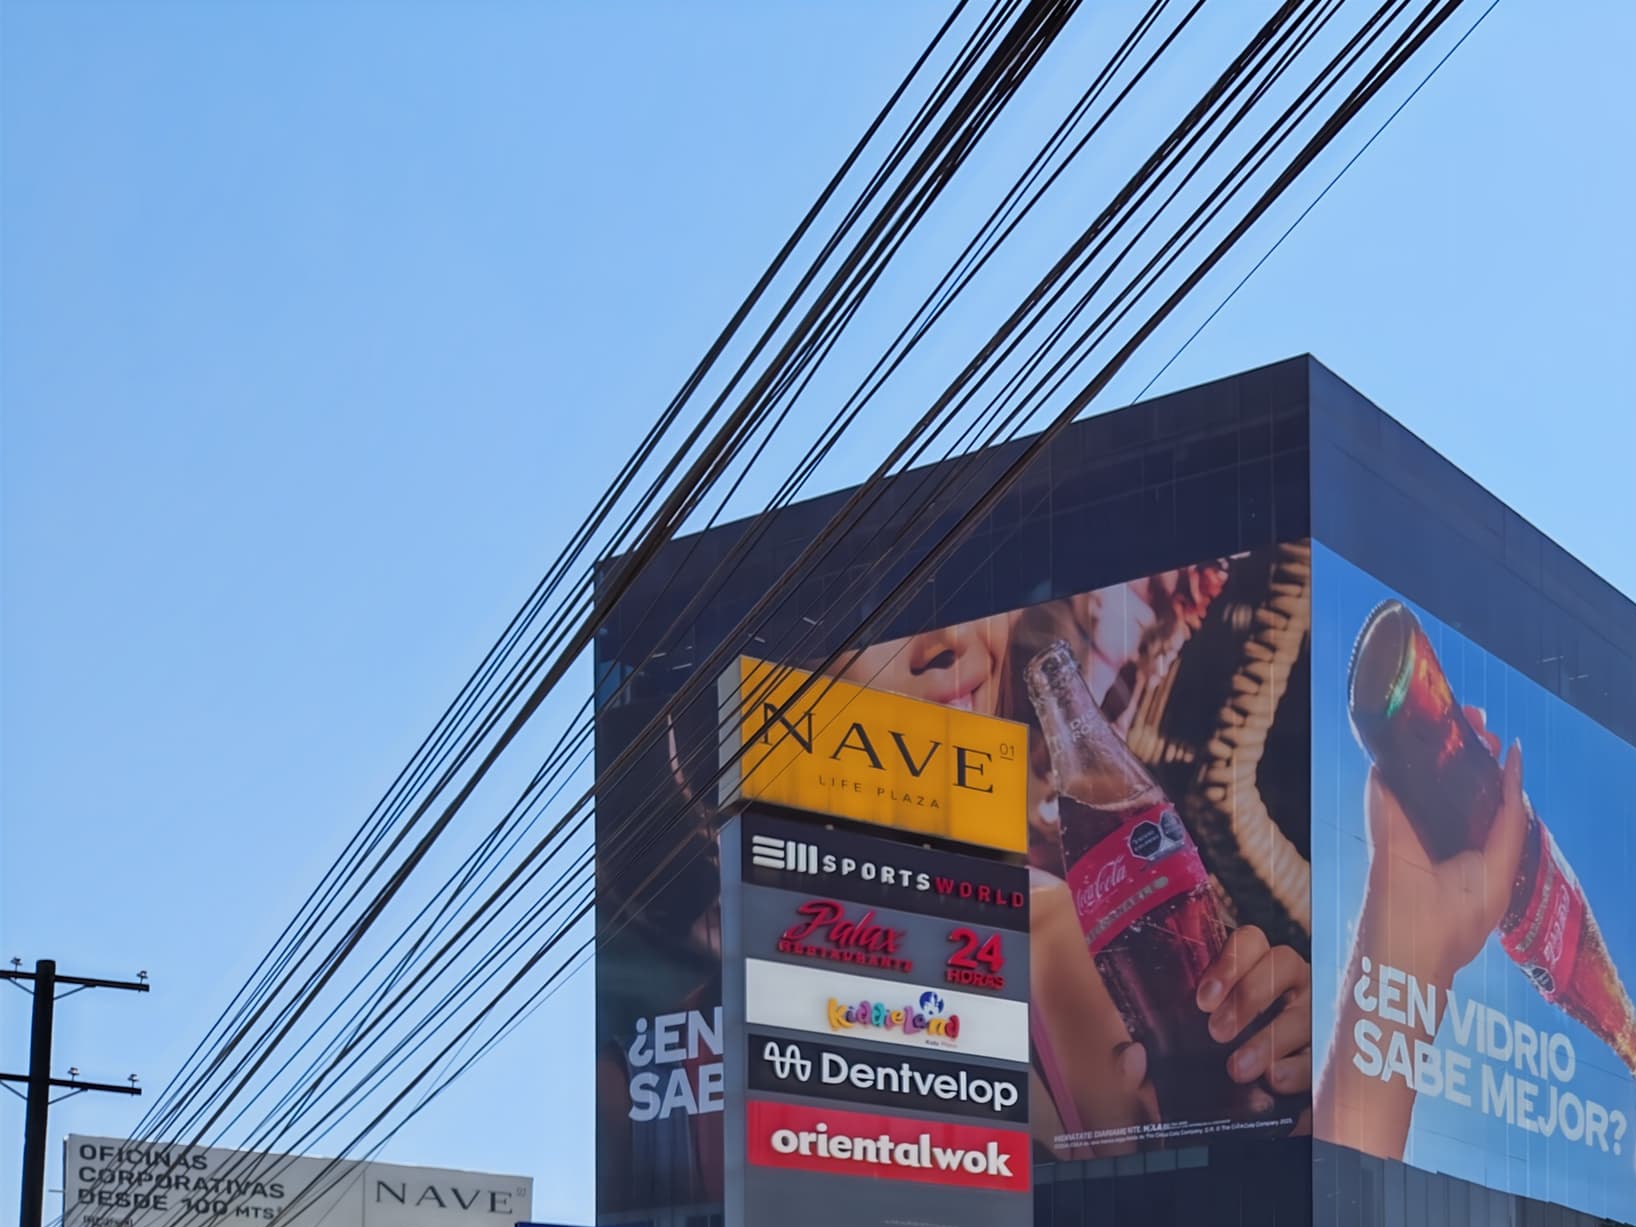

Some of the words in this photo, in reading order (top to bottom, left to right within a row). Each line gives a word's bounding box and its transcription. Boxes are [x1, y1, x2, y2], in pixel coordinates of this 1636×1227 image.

[759, 702, 995, 794] NAVE
[818, 776, 863, 794] LIFE
[877, 787, 940, 809] PLAZA
[783, 899, 905, 954] Palax
[947, 927, 1005, 972] 24
[946, 968, 1006, 990] HORAS
[628, 1006, 723, 1067] ¿EN
[1353, 956, 1436, 1037] ¿EN
[1446, 989, 1576, 1083] VIDRIO
[821, 1052, 1018, 1111] Dentvelop
[1353, 1018, 1472, 1108] SABE
[1481, 1064, 1627, 1156] MEJOR?
[79, 1144, 208, 1170] OFICINAS
[770, 1122, 1013, 1177] orientalwok
[78, 1166, 285, 1198] CORPORATIVAS
[78, 1188, 168, 1211] DESDE
[181, 1198, 229, 1216] 100
[376, 1180, 513, 1214] NAVE
